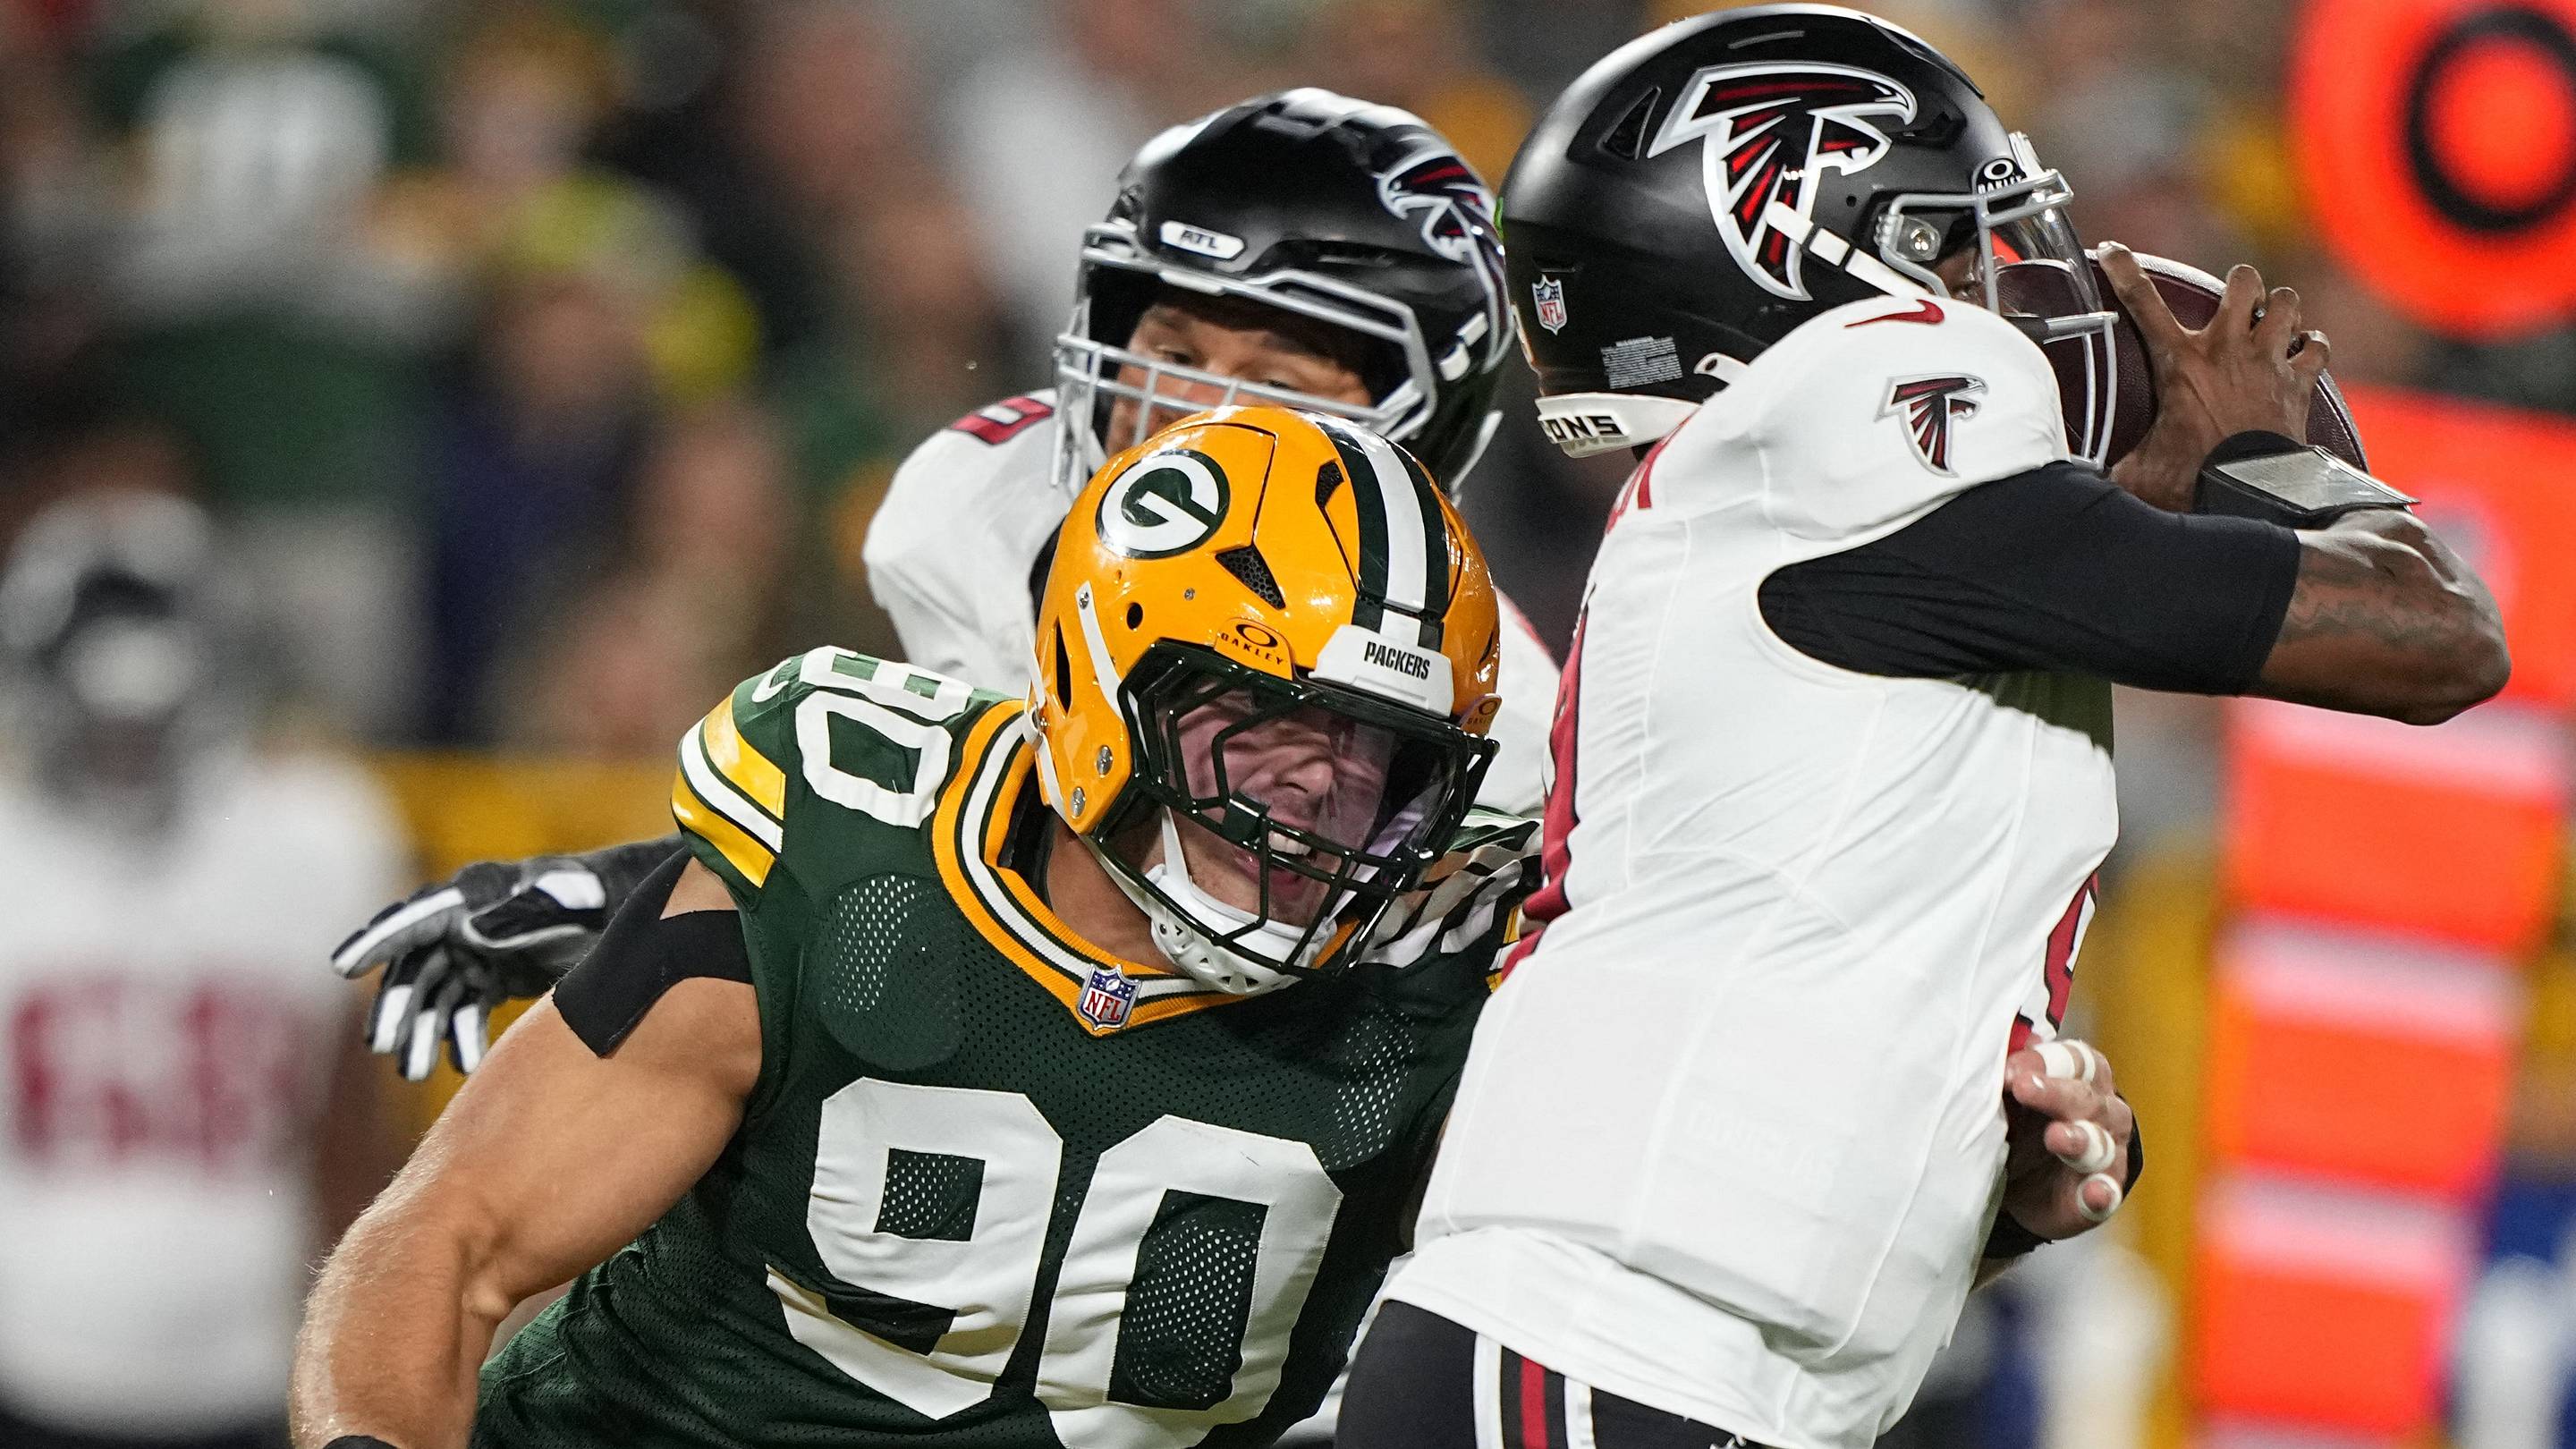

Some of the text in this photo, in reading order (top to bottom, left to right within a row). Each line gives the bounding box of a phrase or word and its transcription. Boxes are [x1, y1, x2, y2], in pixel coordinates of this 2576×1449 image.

[1181, 229, 1217, 249] ATL
[1538, 301, 1565, 325] NFL
[1539, 415, 1625, 444] ONS
[1099, 453, 1220, 553] G
[1220, 632, 1284, 665] OAKLEY
[1363, 640, 1431, 680] PACKERS
[1084, 990, 1122, 1022] NFL
[766, 1076, 1344, 1449] 90
